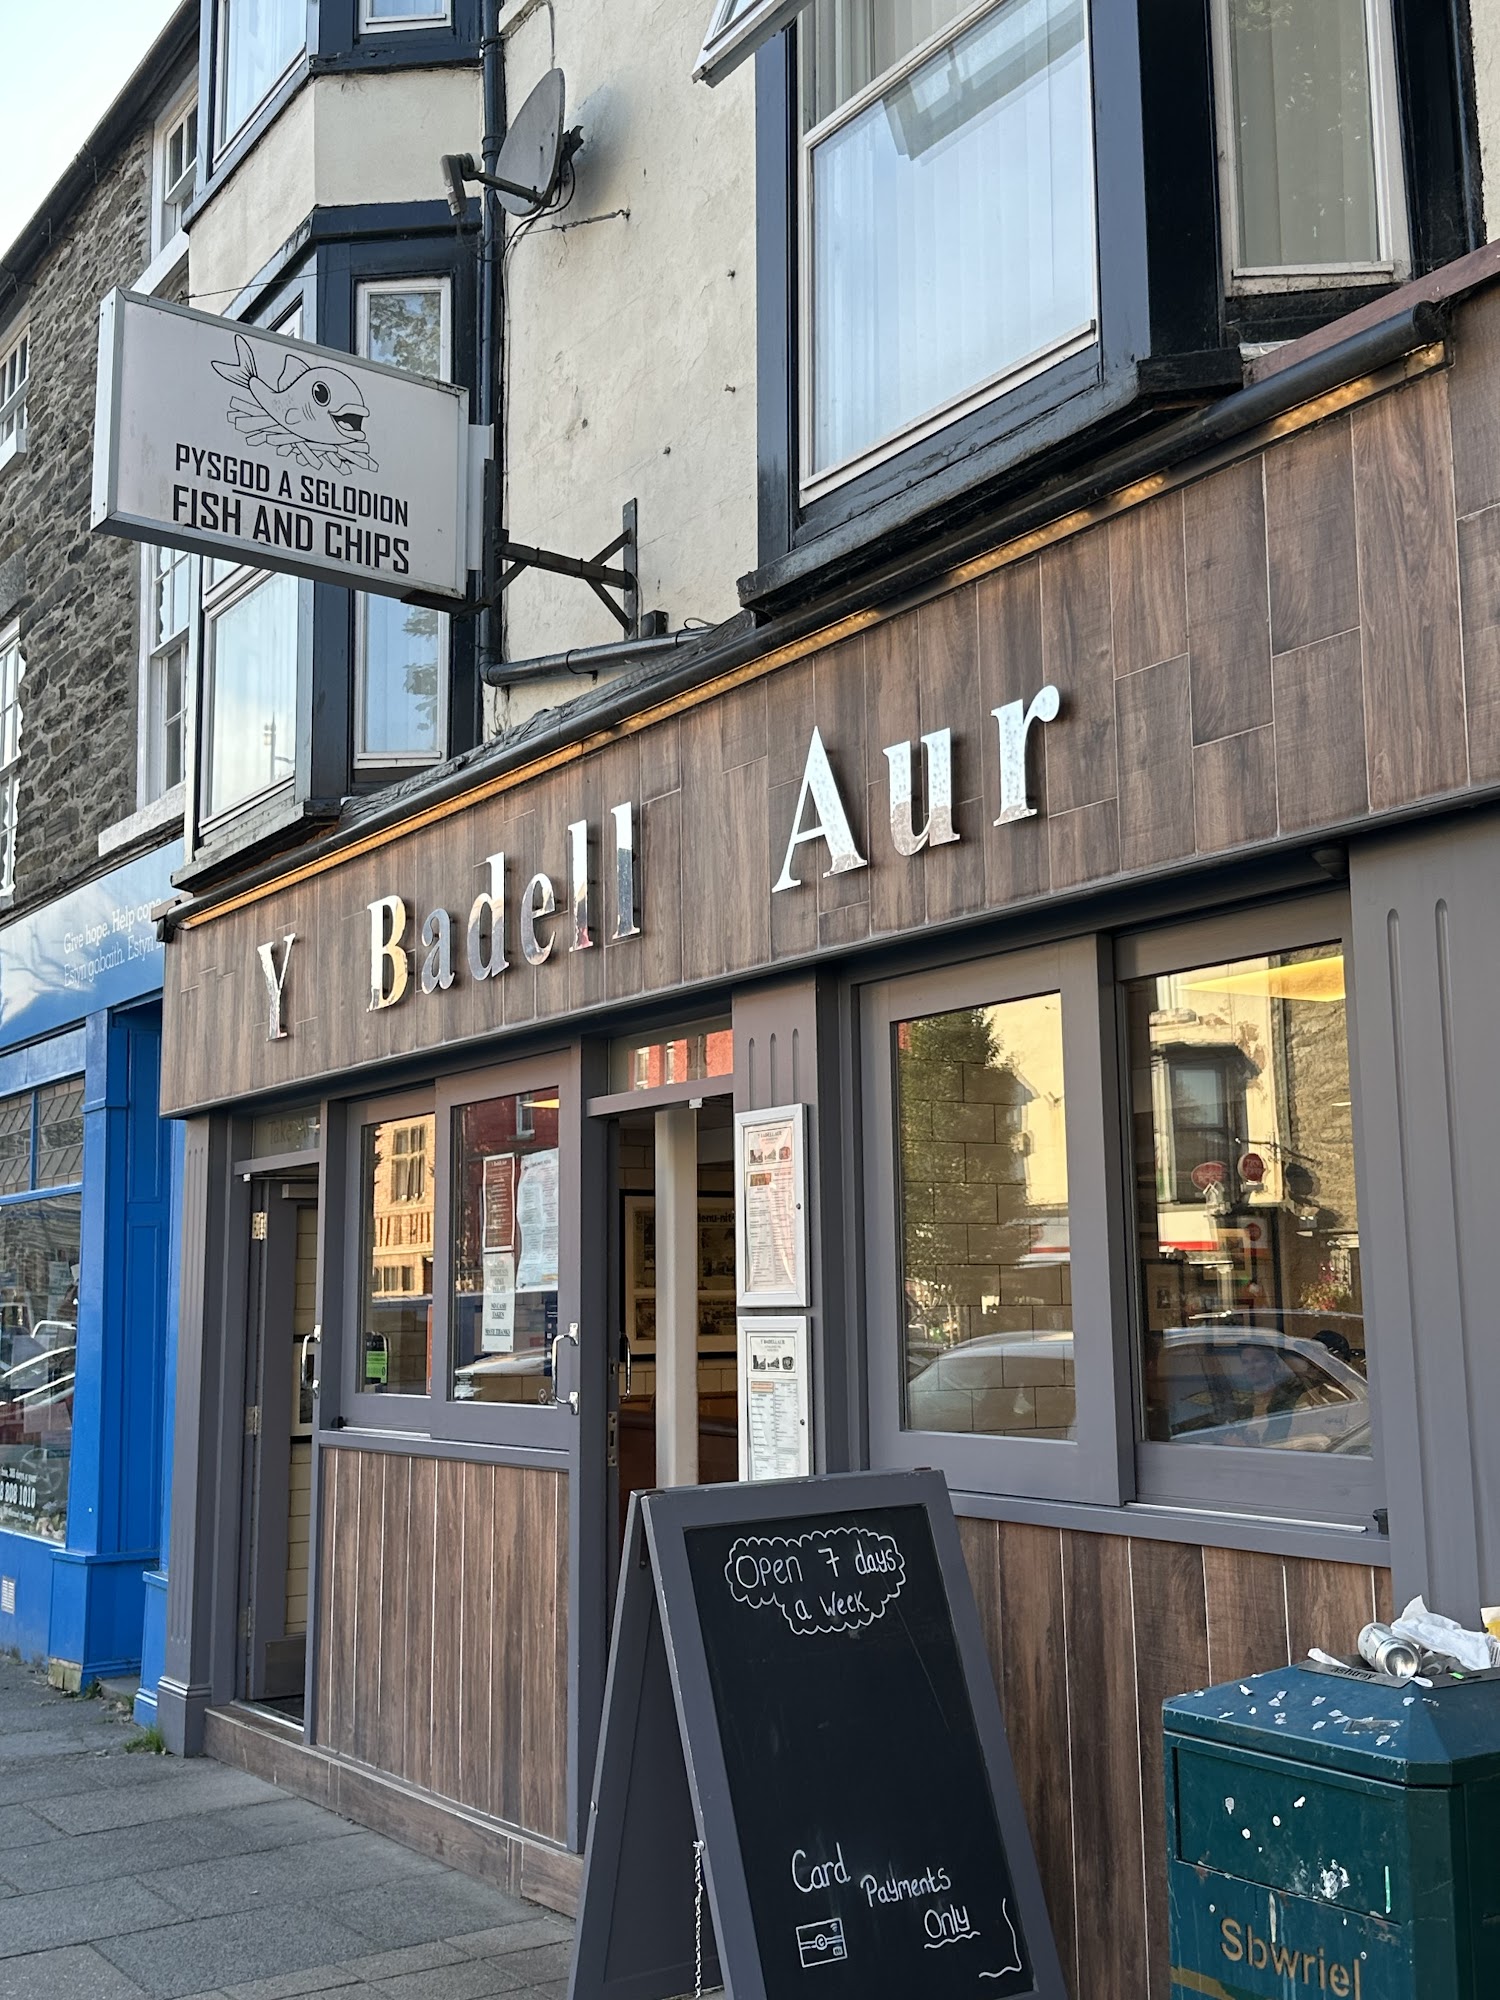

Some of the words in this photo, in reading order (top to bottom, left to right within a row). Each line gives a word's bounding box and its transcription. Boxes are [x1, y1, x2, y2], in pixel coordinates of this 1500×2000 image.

[175, 442, 270, 493] PYSGOD
[278, 470, 293, 499] A
[301, 475, 409, 527] SGLODION
[173, 484, 242, 536] FISH
[252, 504, 313, 552] AND
[324, 521, 410, 575] CHIPS
[257, 932, 298, 1042] Y
[365, 801, 642, 1013] Badell
[771, 684, 1060, 894] Aur
[63, 931, 84, 955] Give
[111, 905, 135, 933] Help
[19, 1485, 36, 1509] 1010
[818, 1548, 840, 1578] 7
[855, 1539, 897, 1575] days
[795, 1599, 812, 1620] a
[1330, 1667, 1377, 1681] ashtray
[791, 1842, 851, 1893] Card
[860, 1867, 951, 1908] Payments
[924, 1903, 970, 1939] Only
[1220, 1917, 1361, 2000] Sbwriel
